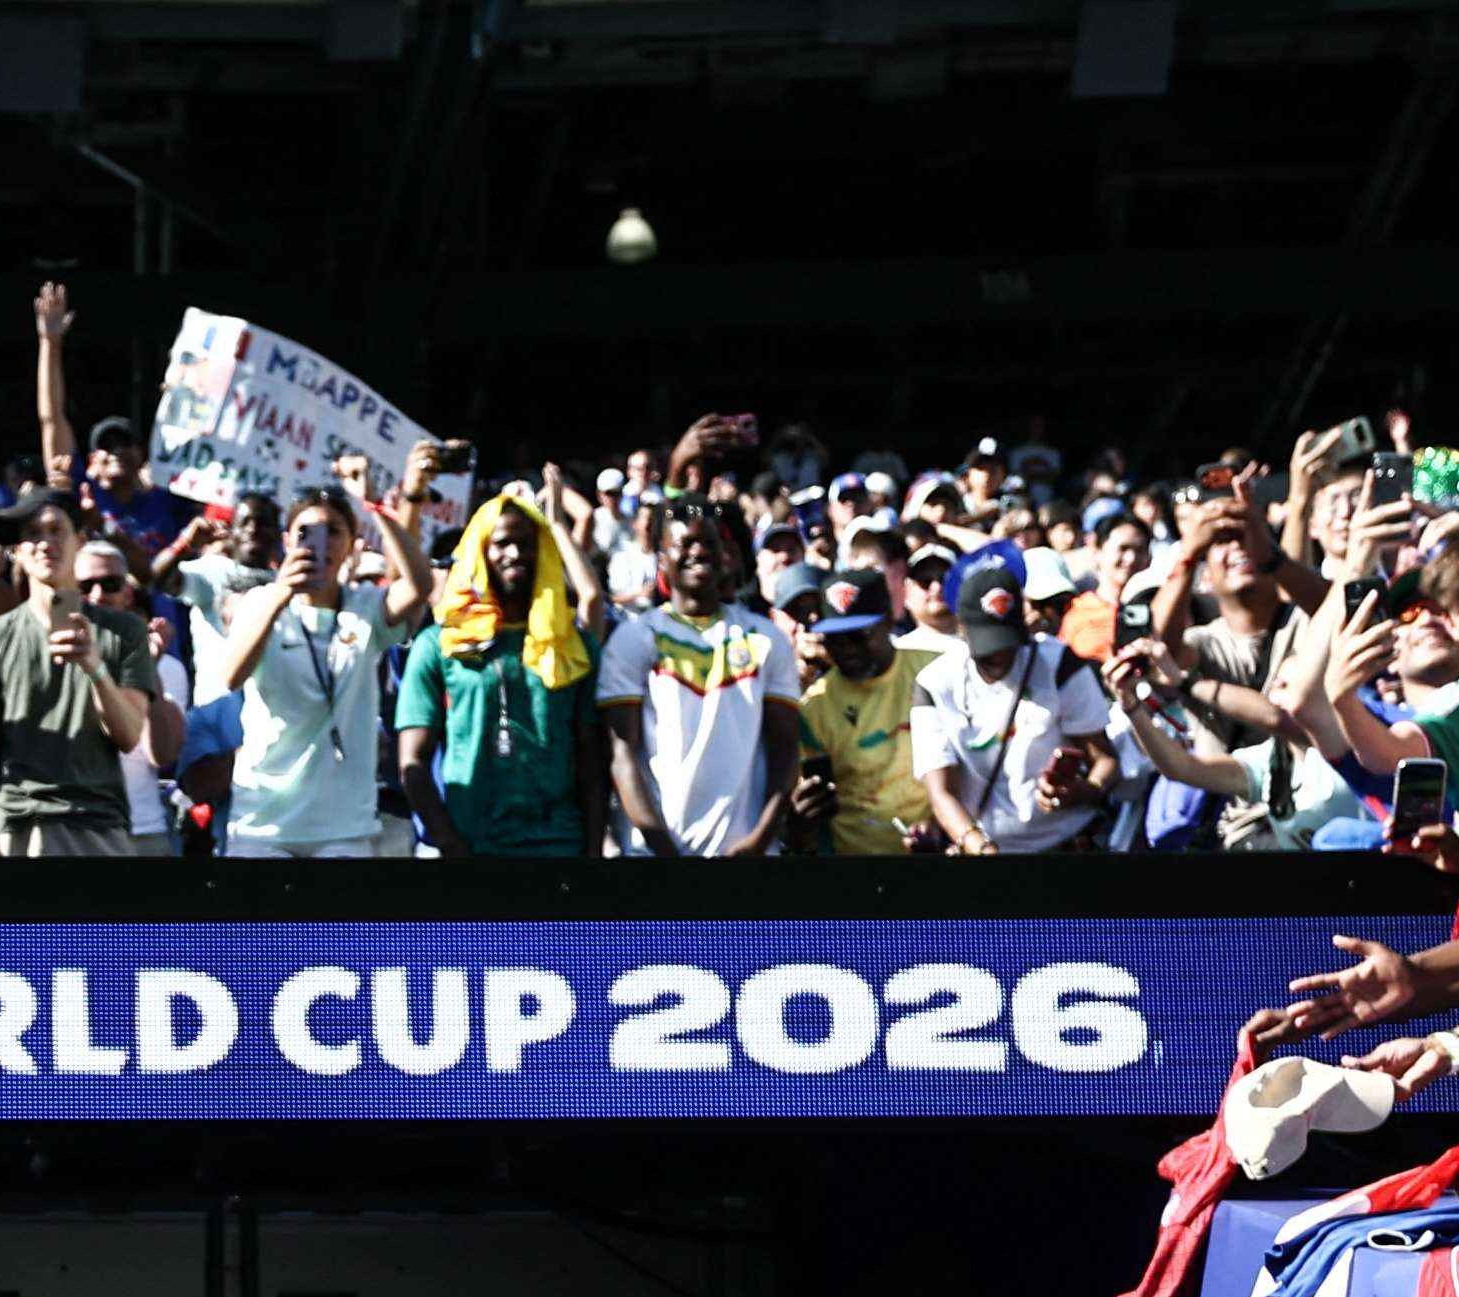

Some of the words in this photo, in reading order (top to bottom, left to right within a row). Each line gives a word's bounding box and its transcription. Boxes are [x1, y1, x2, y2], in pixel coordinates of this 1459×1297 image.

[266, 343, 400, 443] MBAPPE
[269, 963, 579, 1077] CUP
[607, 962, 1148, 1077] 2026
